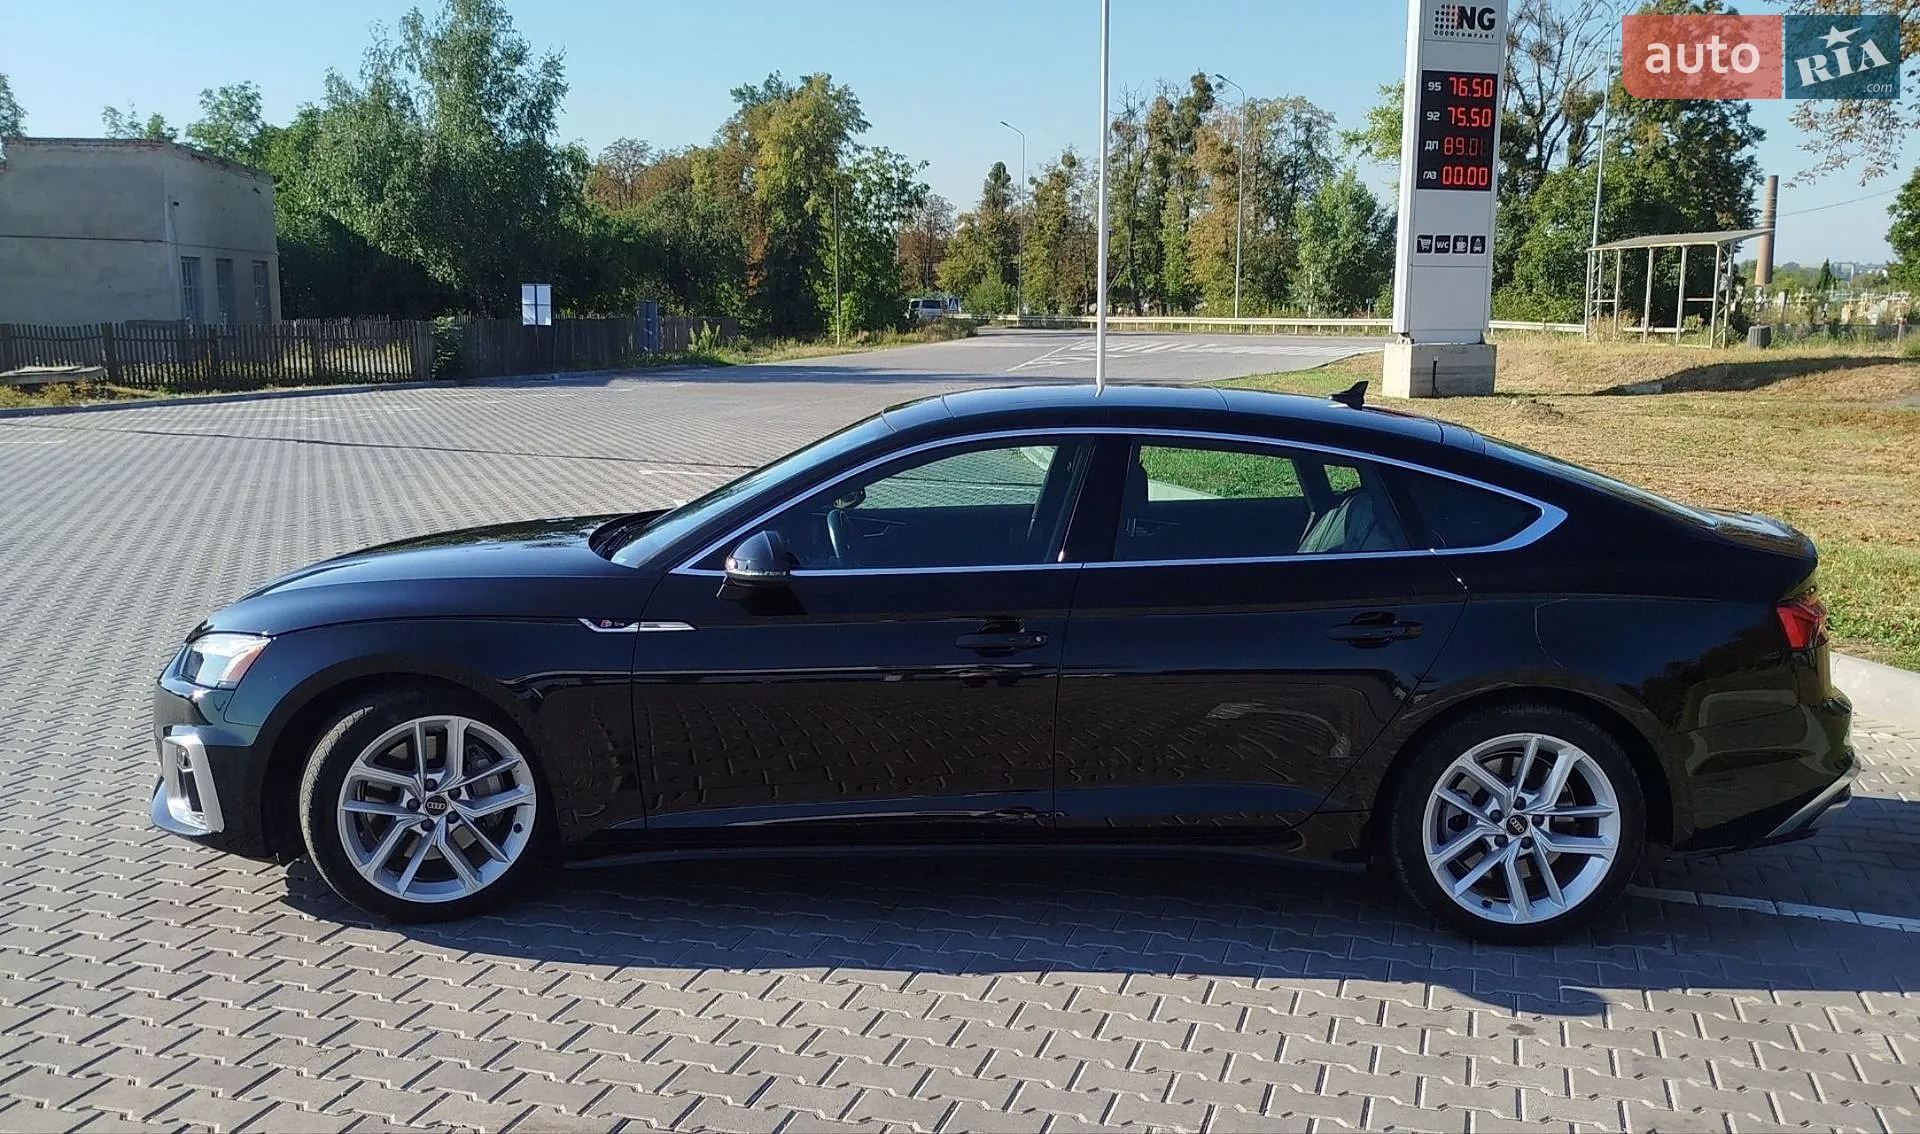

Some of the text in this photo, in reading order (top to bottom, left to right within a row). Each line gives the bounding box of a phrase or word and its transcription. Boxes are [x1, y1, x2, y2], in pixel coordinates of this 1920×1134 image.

[1428, 77, 1493, 98] 95 76.50
[1426, 106, 1492, 127] 92 75.50
[1424, 140, 1439, 151] ДП
[1423, 166, 1488, 186] ГАЗ 00.00
[1436, 241, 1449, 249] WC
